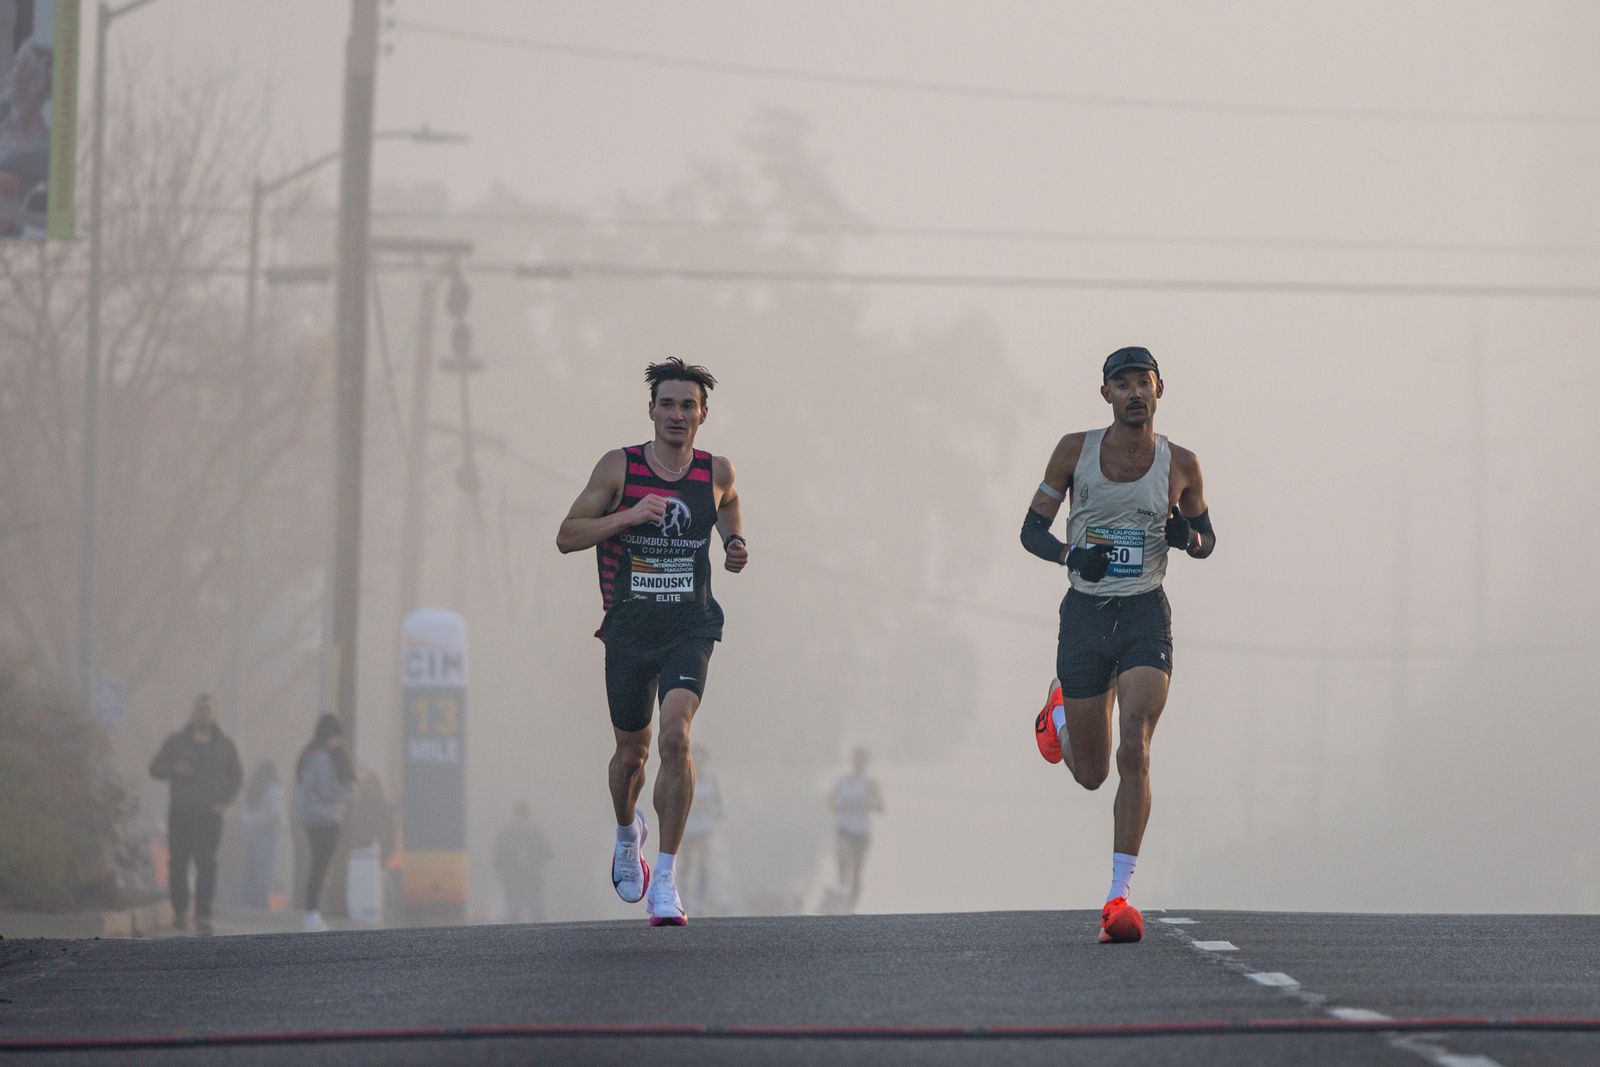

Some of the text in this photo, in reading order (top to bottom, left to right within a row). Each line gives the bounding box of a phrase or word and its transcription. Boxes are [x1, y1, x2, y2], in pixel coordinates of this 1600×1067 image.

[620, 534, 669, 547] COLUMBUS
[642, 547, 686, 555] COMPANY
[632, 576, 693, 588] SANDUSKY
[656, 594, 681, 602] ELITE
[403, 651, 465, 679] CIM
[411, 696, 457, 735] 13
[409, 735, 458, 763] MILE
